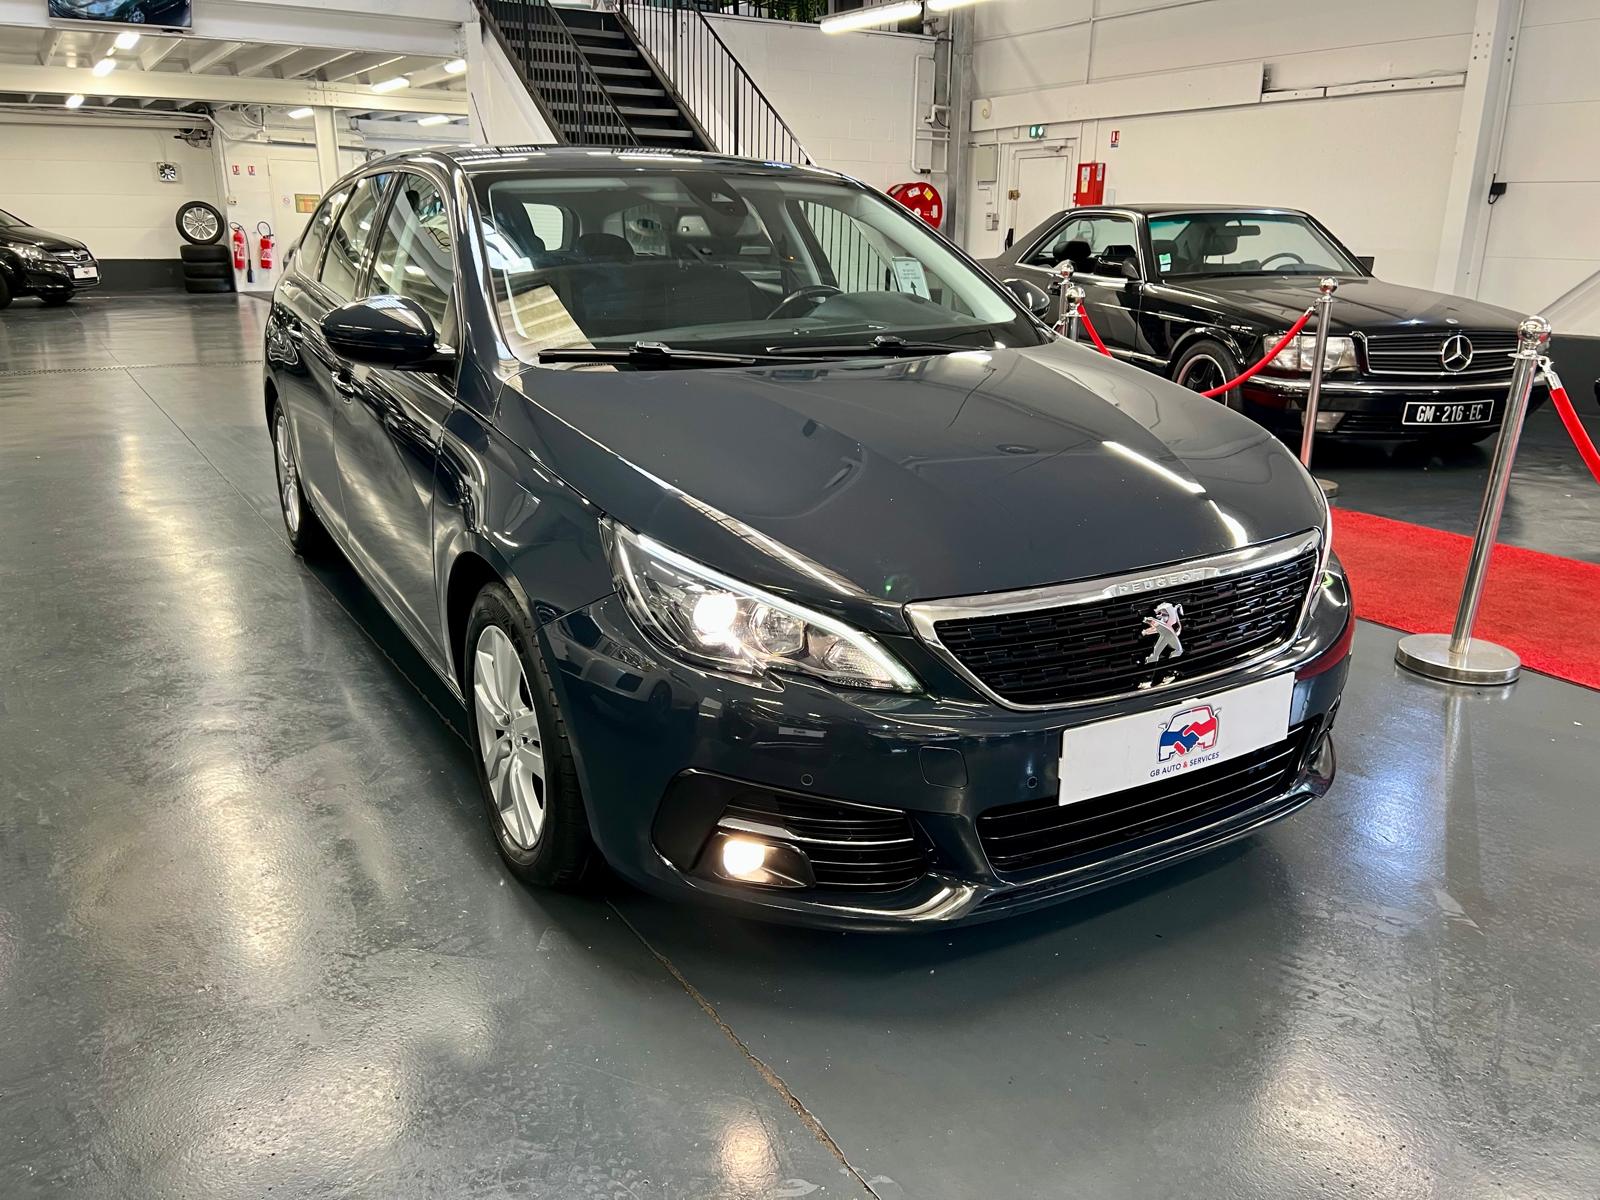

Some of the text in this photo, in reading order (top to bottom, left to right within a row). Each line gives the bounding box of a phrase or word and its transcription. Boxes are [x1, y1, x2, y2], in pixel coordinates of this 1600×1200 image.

[1119, 571, 1200, 592] PEUGEOT
[1149, 768, 1160, 777] GB
[1161, 763, 1181, 774] AUTO
[1189, 751, 1220, 766] SERVICES
